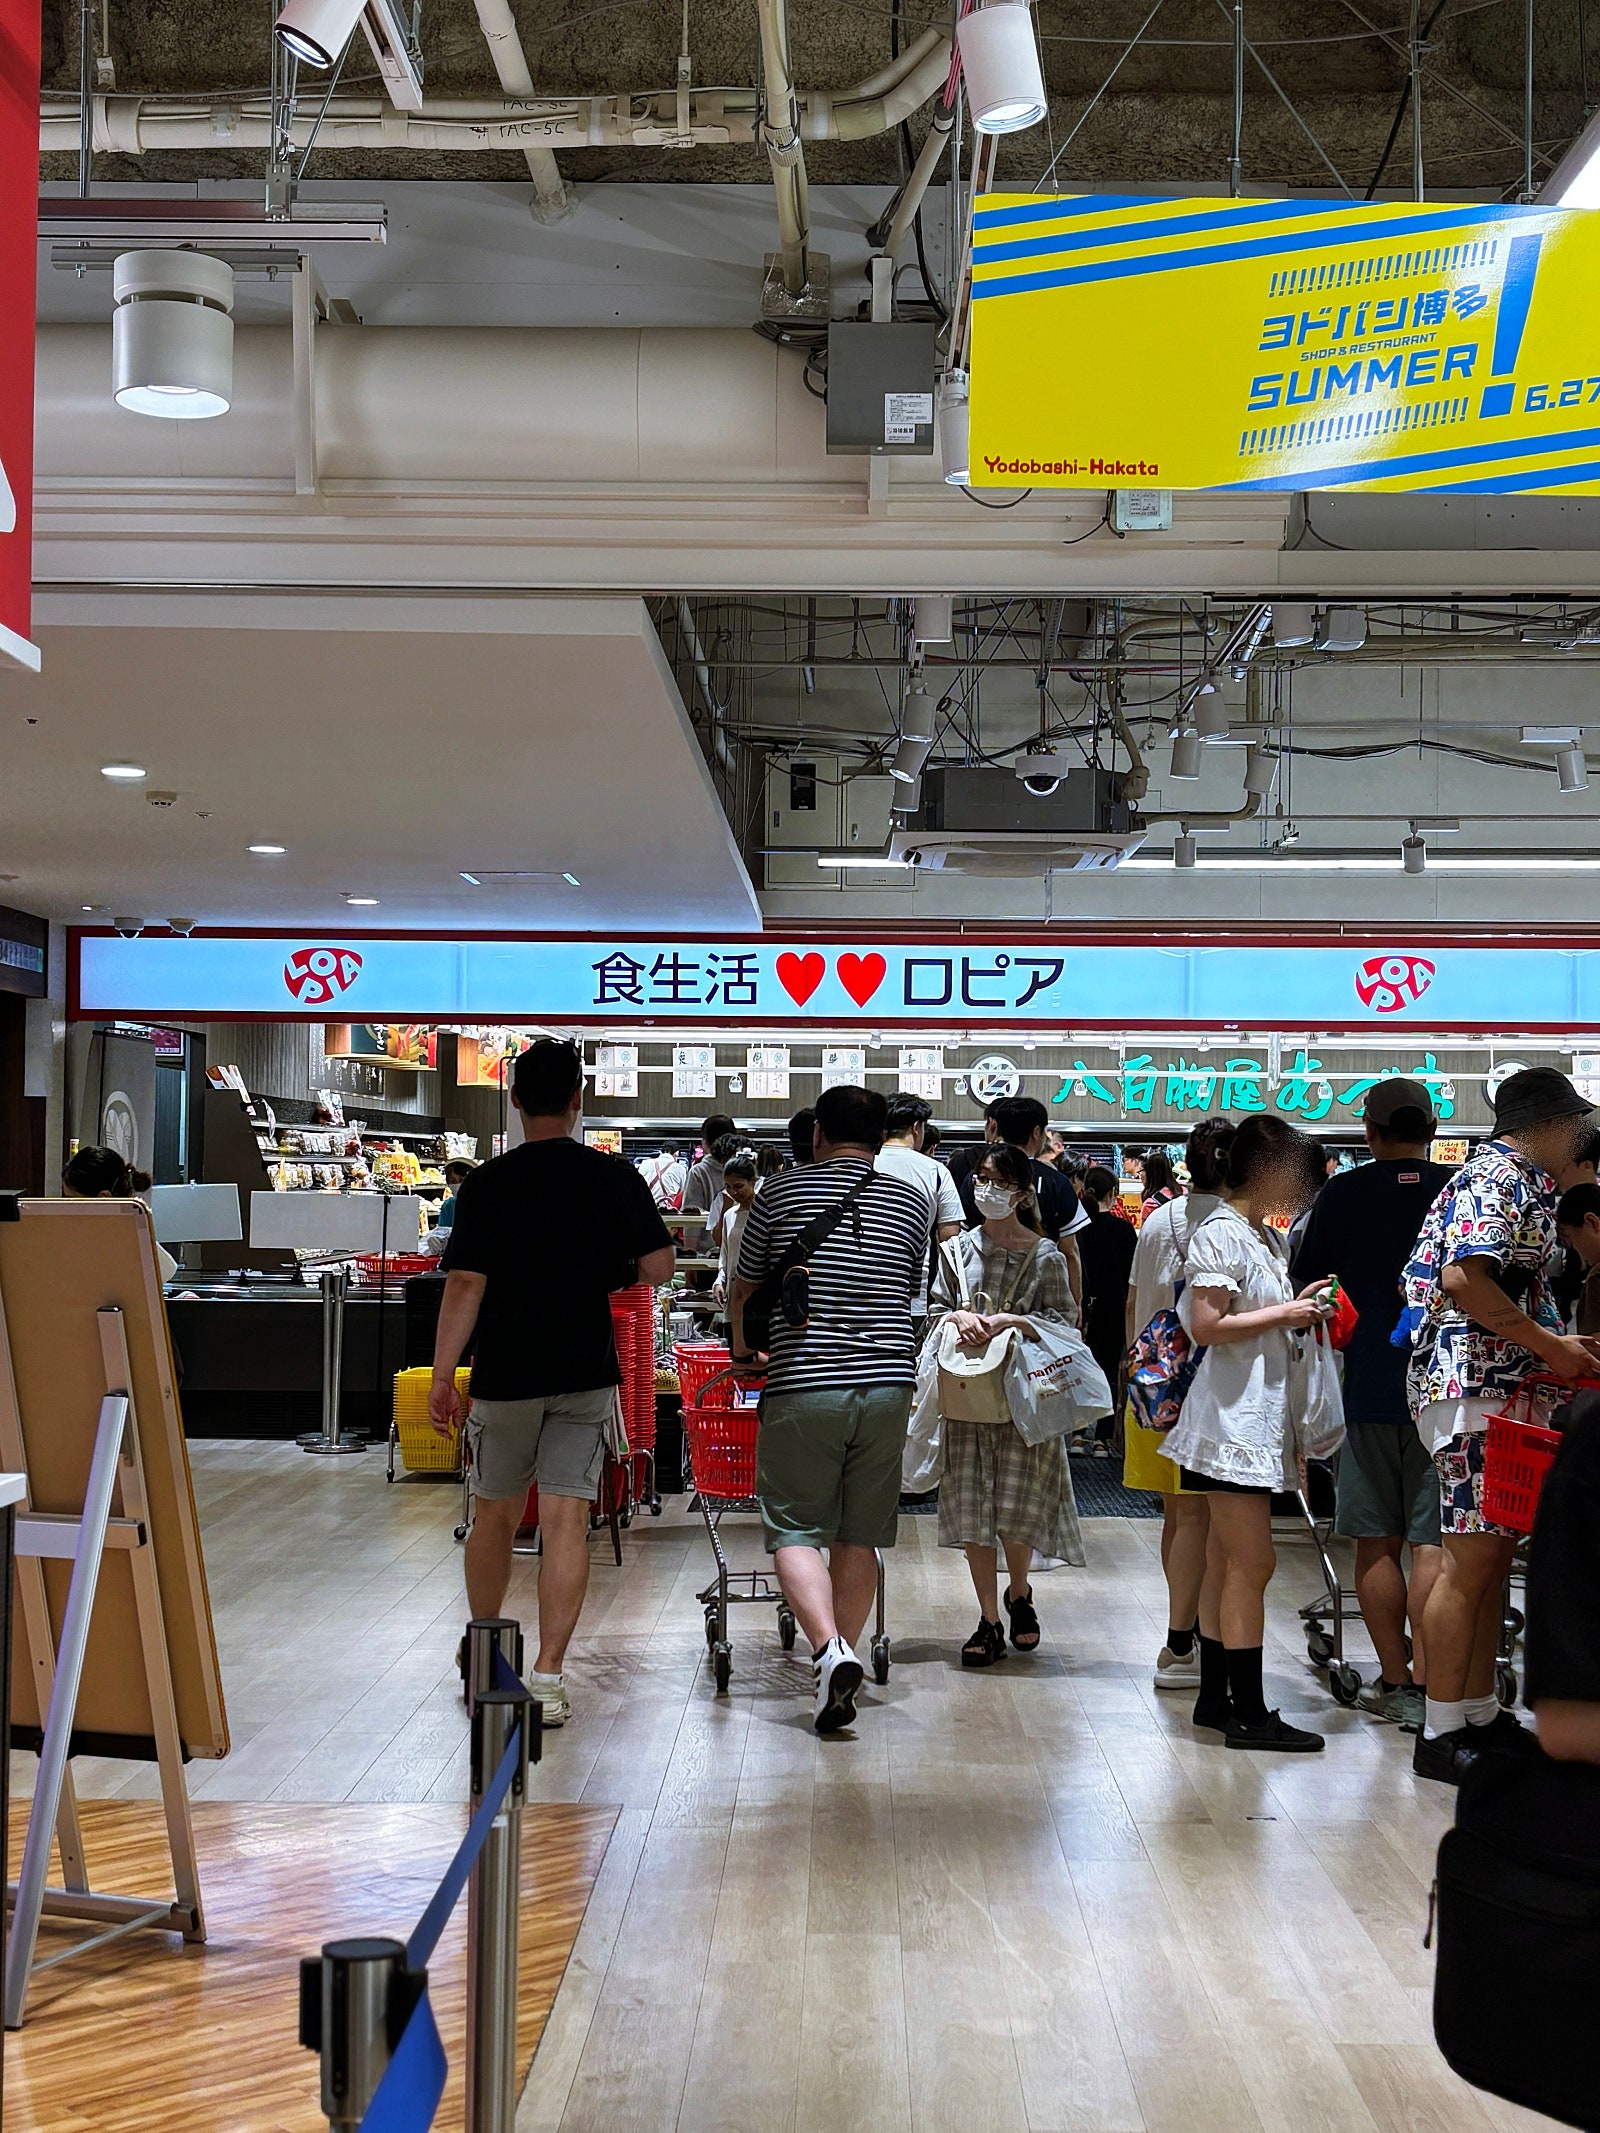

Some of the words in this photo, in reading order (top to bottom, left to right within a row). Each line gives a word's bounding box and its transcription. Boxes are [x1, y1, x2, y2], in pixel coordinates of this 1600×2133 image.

[1259, 284, 1488, 351] ヨドバシ博多
[1301, 346, 1337, 362] SHOP
[1338, 345, 1347, 356] &
[1349, 332, 1437, 355] RESTAURANT
[1247, 343, 1479, 412] SUMMER
[983, 455, 1159, 476] Yodobashi-Hakata
[591, 951, 760, 1006] 食生活
[904, 953, 1065, 1007] ロピア
[1269, 1216, 1291, 1229] 100
[1026, 1355, 1073, 1381] namco
